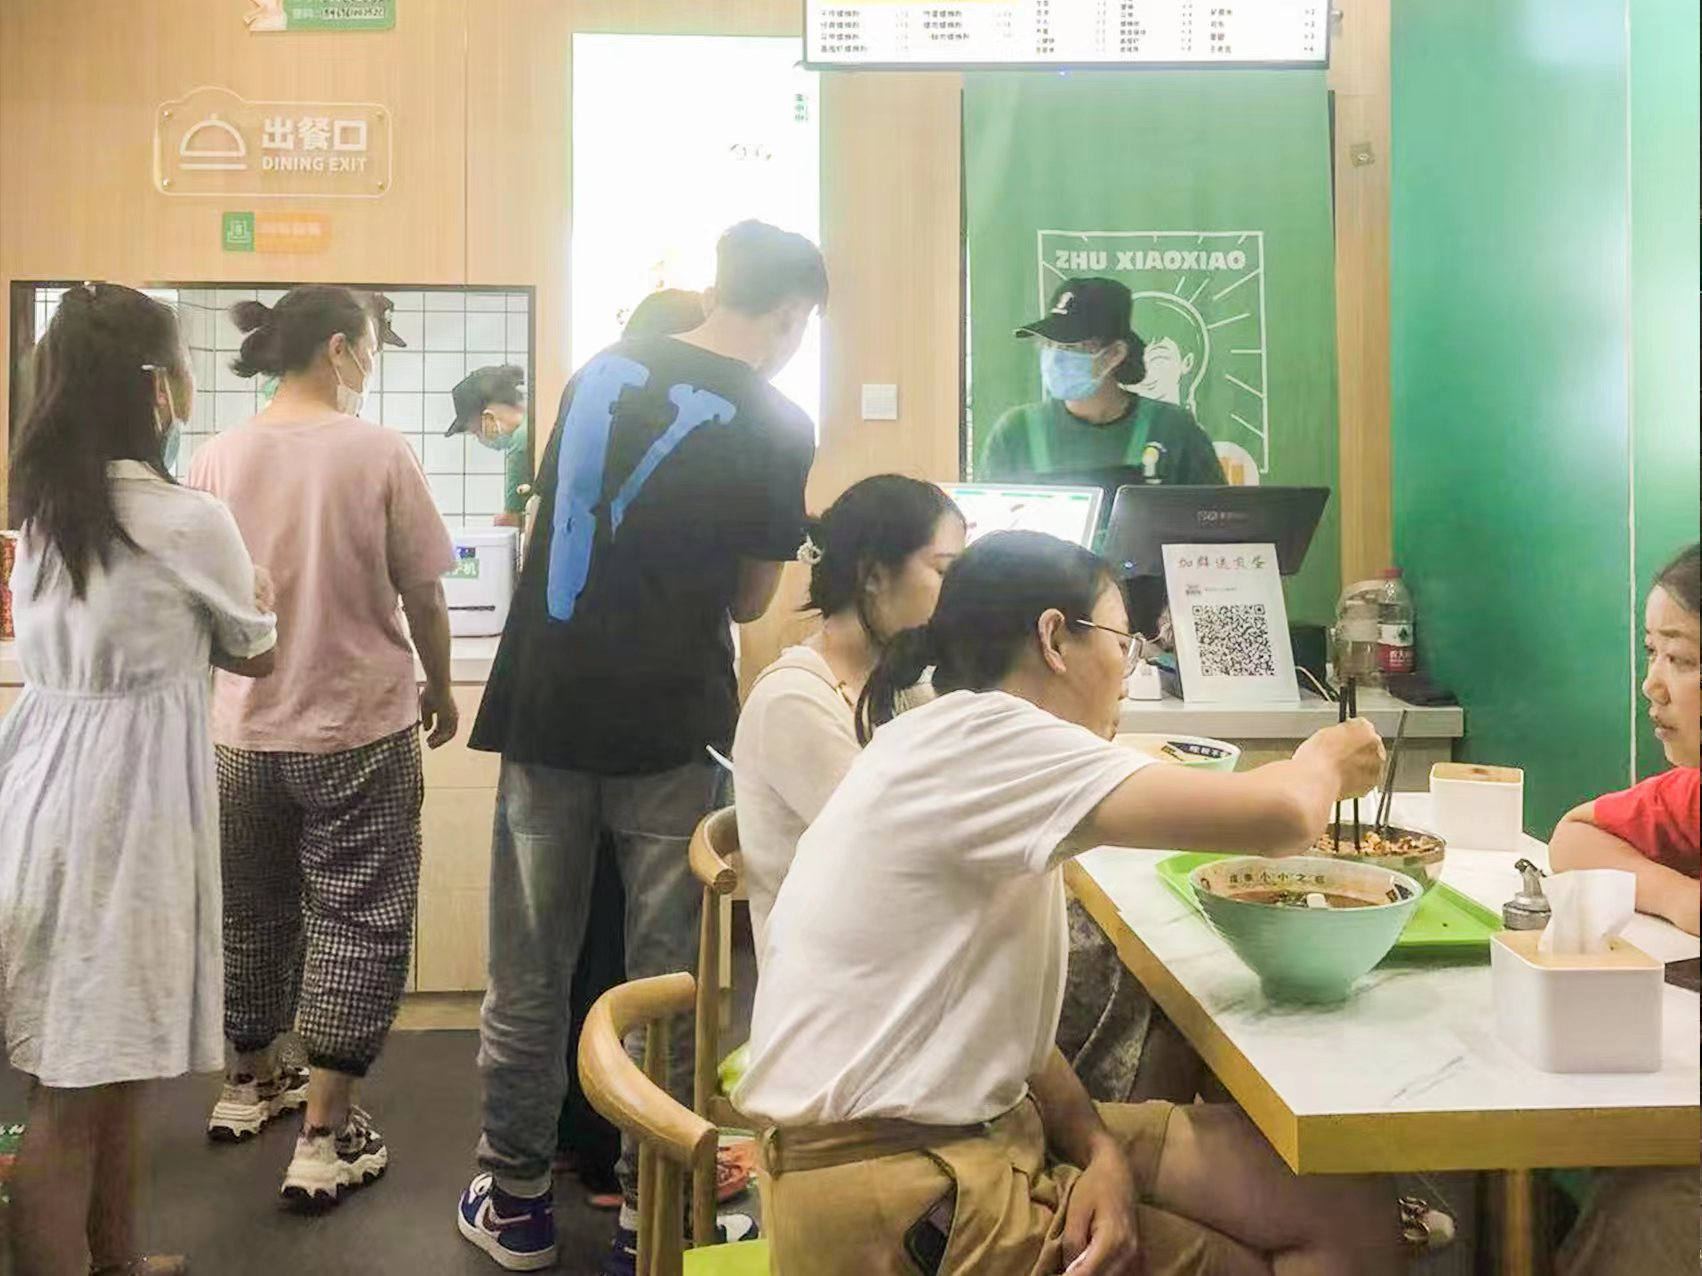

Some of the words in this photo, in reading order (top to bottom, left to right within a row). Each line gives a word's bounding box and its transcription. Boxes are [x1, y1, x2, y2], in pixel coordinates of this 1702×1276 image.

[262, 117, 368, 151] 出餐口
[262, 156, 324, 171] DINING
[329, 157, 367, 172] EXIT
[1055, 250, 1108, 270] ZHU
[1116, 250, 1247, 270] XIAOXIAO
